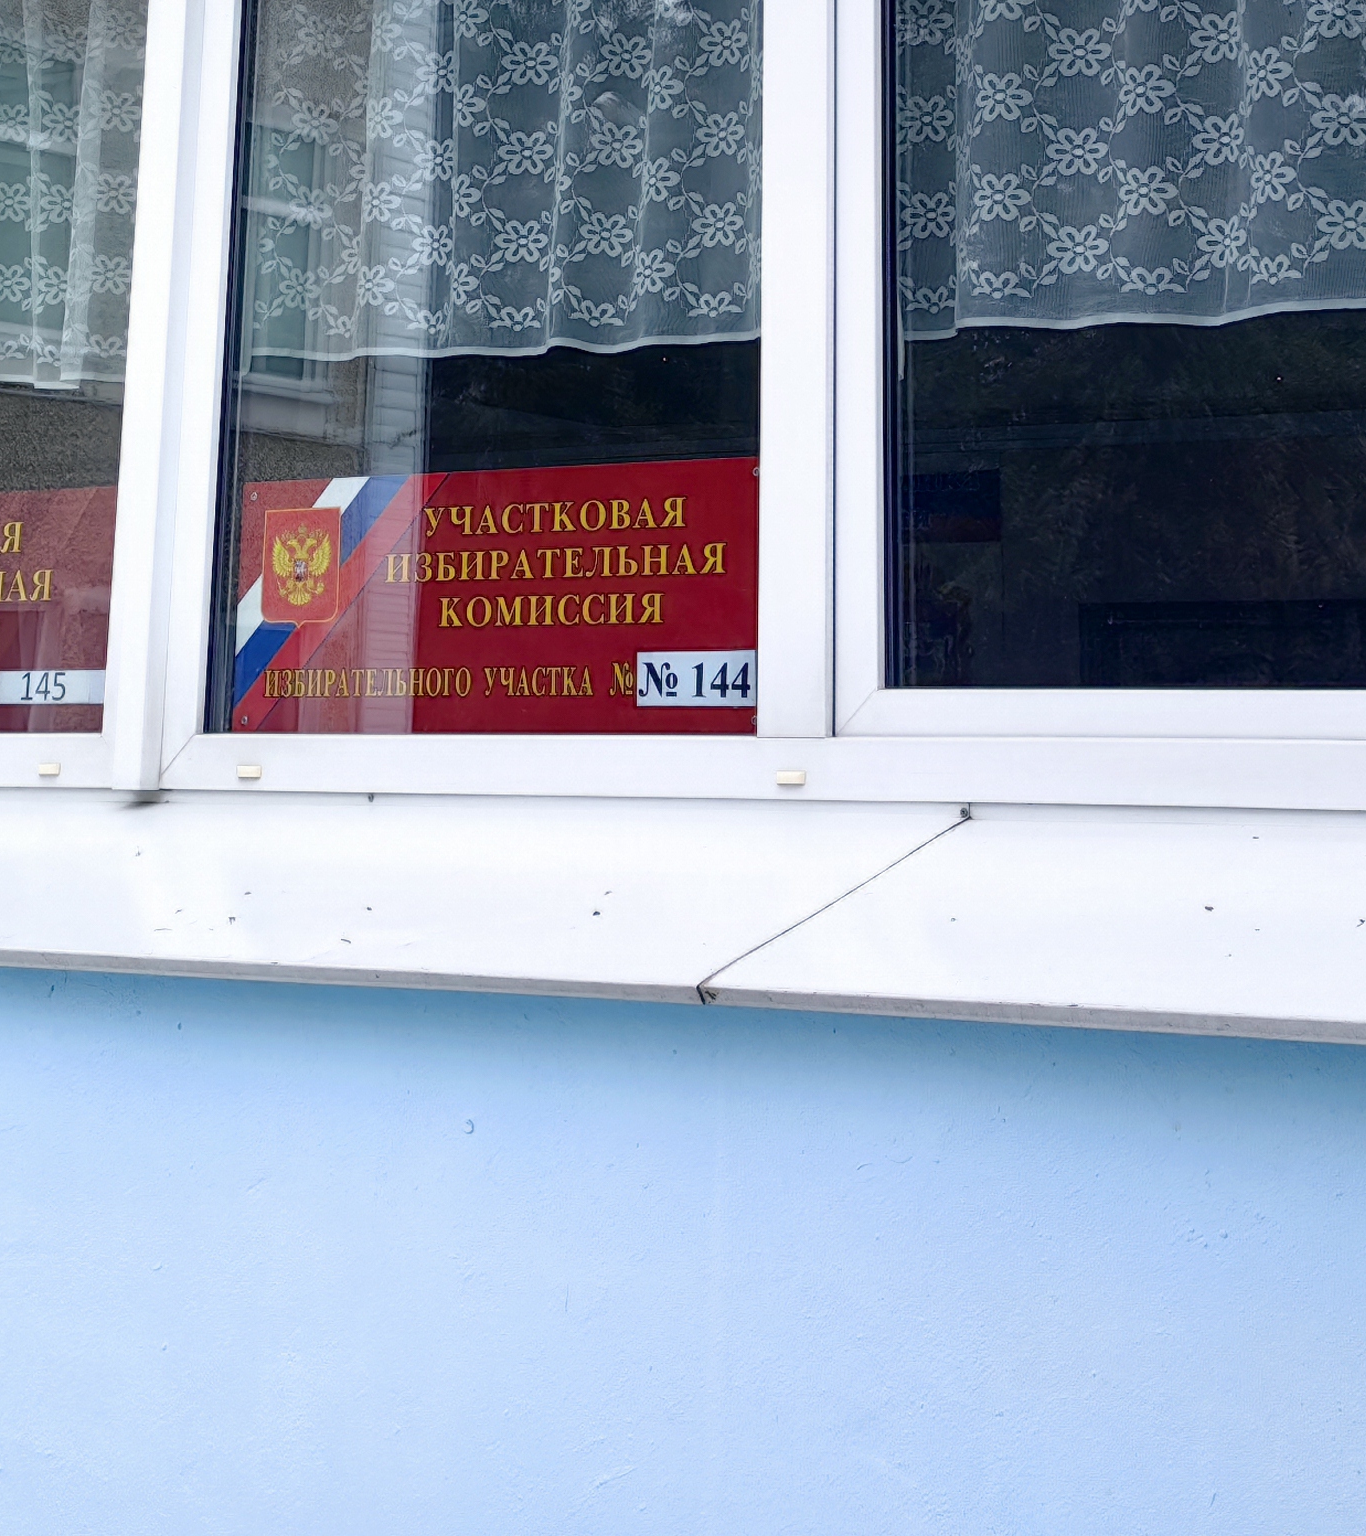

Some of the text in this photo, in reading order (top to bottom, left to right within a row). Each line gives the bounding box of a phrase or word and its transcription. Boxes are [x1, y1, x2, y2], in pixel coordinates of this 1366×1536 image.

[425, 497, 686, 538] УЧАСТКОВАЯ
[385, 543, 727, 583] ИЗБИРАТЕЛЬНАЯ
[439, 593, 664, 628] КОМИССИЯ
[20, 672, 66, 702] 145
[264, 667, 472, 699] ИЗБИРАТЕЛЬНОГО
[485, 667, 593, 697] УЧАСТКА
[639, 662, 678, 698] №
[692, 662, 751, 698] 144
